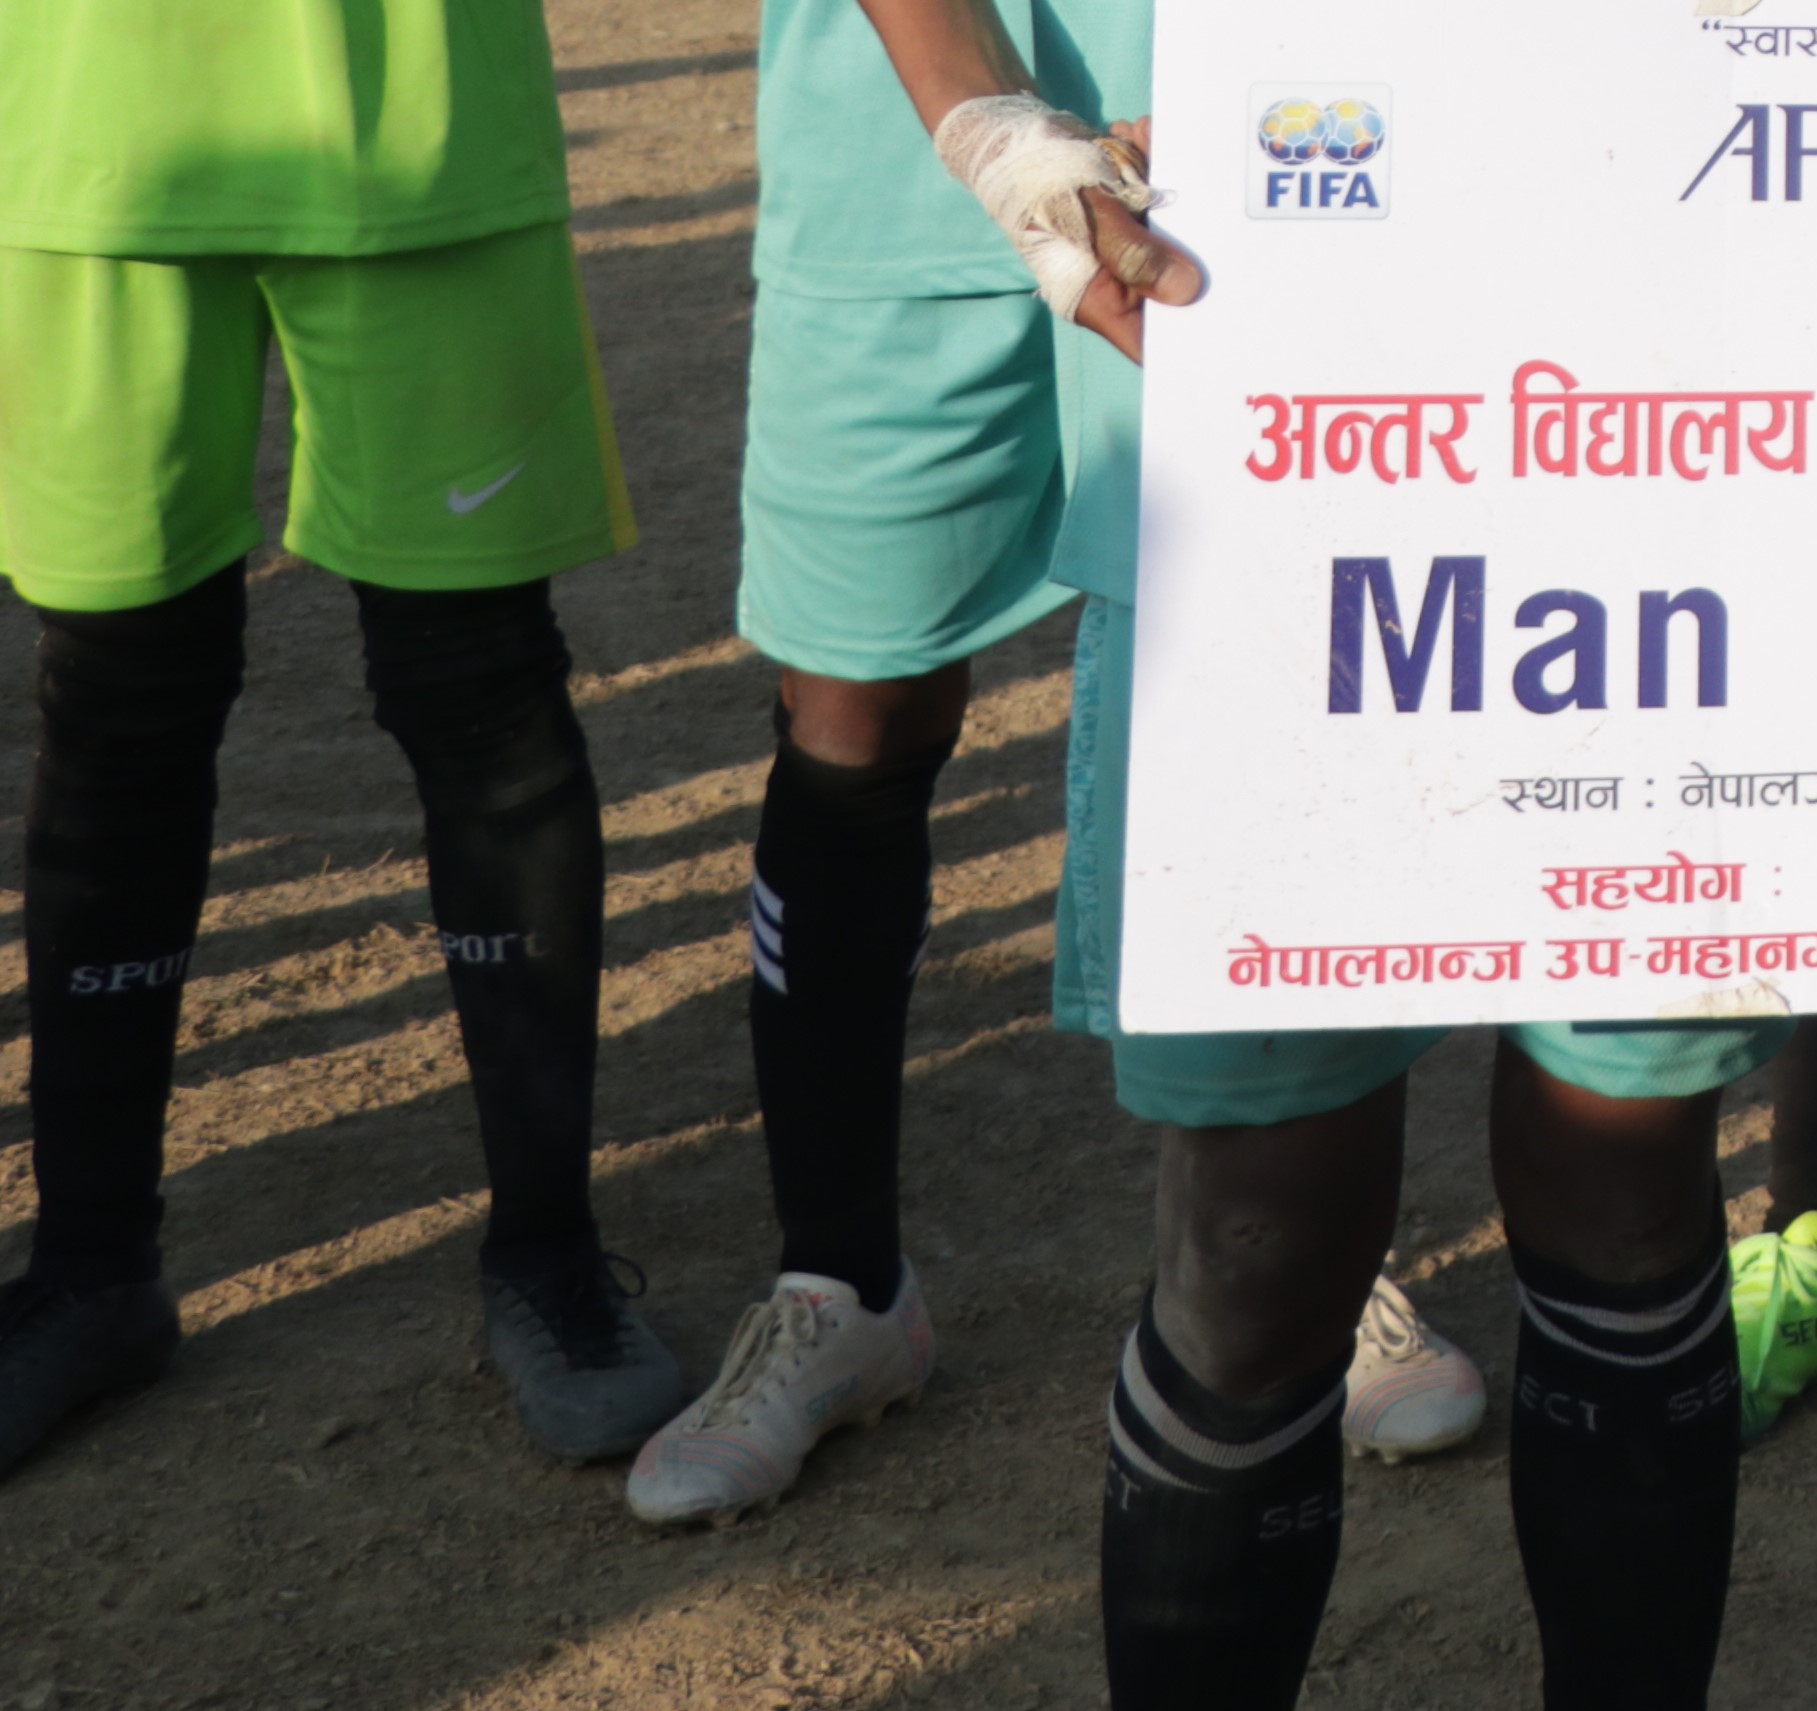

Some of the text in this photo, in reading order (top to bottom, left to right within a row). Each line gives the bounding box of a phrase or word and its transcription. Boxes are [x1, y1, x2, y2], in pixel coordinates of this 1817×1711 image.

[1267, 172, 1379, 208] FIFA
[1245, 394, 1484, 485] अन्तर
[1510, 360, 1814, 482] विद्यालय
[1328, 555, 1727, 715] Man
[1542, 851, 1744, 911] सहयोग
[1228, 934, 1525, 988] नेपालगन्ज
